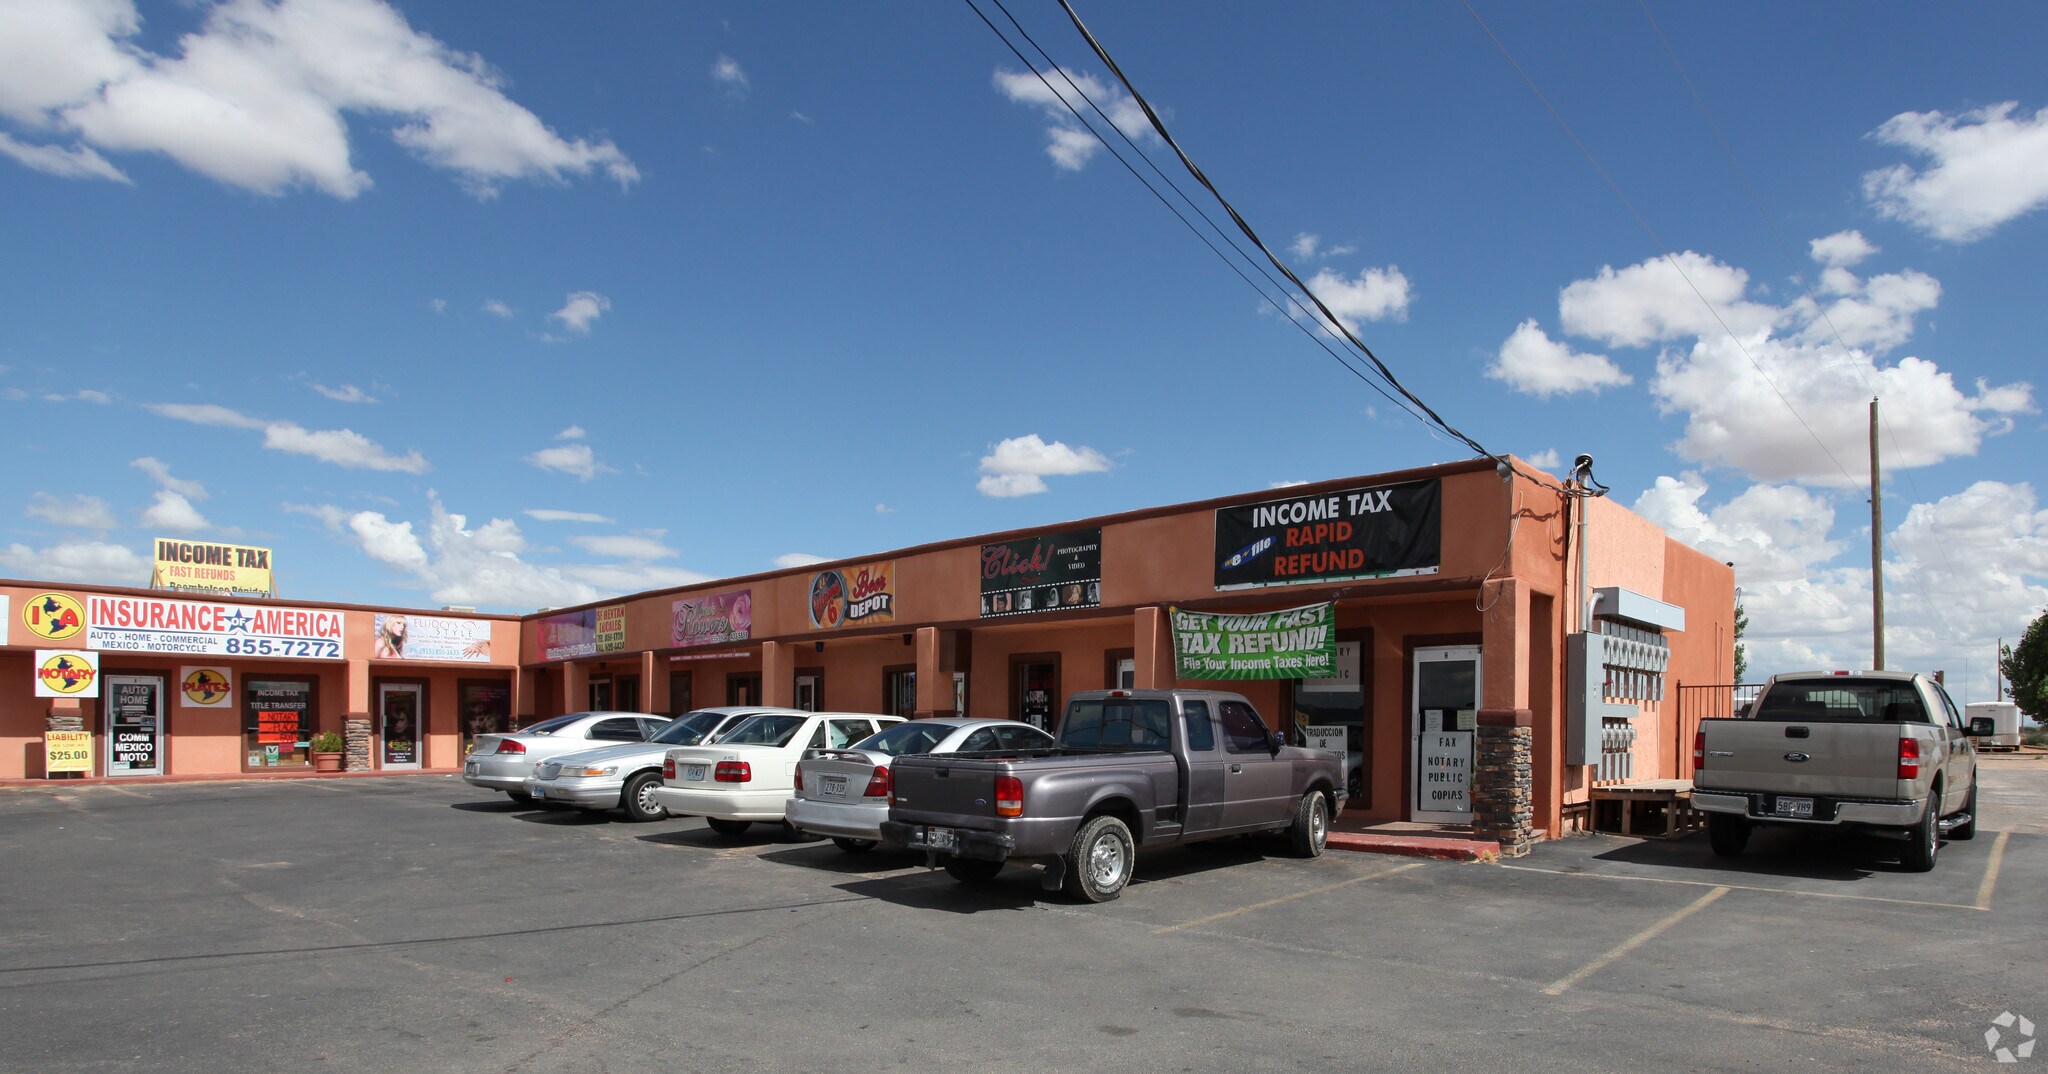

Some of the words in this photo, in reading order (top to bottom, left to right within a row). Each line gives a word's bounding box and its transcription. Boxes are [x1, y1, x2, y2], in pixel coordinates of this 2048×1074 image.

[1252, 497, 1339, 528] INCOME
[1347, 489, 1393, 516] TAX
[1286, 521, 1353, 547] RAPID
[158, 541, 232, 566] INCOME
[235, 548, 269, 569] TAX
[1057, 544, 1098, 555] PHOTOGRAPHY
[981, 543, 1055, 579] Click!
[1067, 562, 1086, 570] VIDEO
[1274, 548, 1365, 577] REFUND
[169, 566, 192, 577] FAST
[194, 568, 235, 581] REFUNDS
[853, 569, 886, 599] Beer
[850, 595, 889, 618] DEPOT
[91, 598, 226, 632] INSURANCE
[231, 617, 246, 626] OF
[252, 609, 342, 638] AMERICA
[1176, 612, 1215, 631] GET
[1216, 613, 1274, 632] YOUR
[1274, 603, 1329, 630] FAST
[599, 620, 621, 633] LOCALES
[90, 632, 116, 640] AUTO
[125, 633, 151, 642] HOME
[160, 634, 218, 645] COMMERCIAL
[1179, 632, 1222, 655] TAX
[1228, 625, 1328, 654] REFUND!
[102, 640, 139, 650] MEXICO
[147, 643, 207, 653] MOTORCYCLE
[226, 638, 340, 657] 855-7272
[1183, 657, 1200, 669] File
[1202, 657, 1227, 670] Your
[1230, 657, 1270, 670] Income
[1273, 655, 1302, 668] Taxes
[1305, 652, 1330, 667] Here!
[38, 668, 97, 680] NOTARY
[122, 686, 149, 695] AUTO
[182, 681, 231, 692] PLATES
[257, 689, 284, 697] INCOME
[120, 696, 149, 705] HOME
[47, 733, 89, 741] LIABILITY
[119, 733, 149, 742] COMM
[1306, 728, 1343, 737] TRADUCCION
[115, 743, 153, 752] MEXICO
[1319, 739, 1327, 748] DE
[1439, 738, 1456, 748] FAX
[49, 750, 88, 760] $25.00
[120, 753, 148, 762] MOTO
[1428, 757, 1465, 767] NOTARY
[1428, 773, 1463, 783] PUBLIC
[1432, 791, 1463, 800] COPIAS
